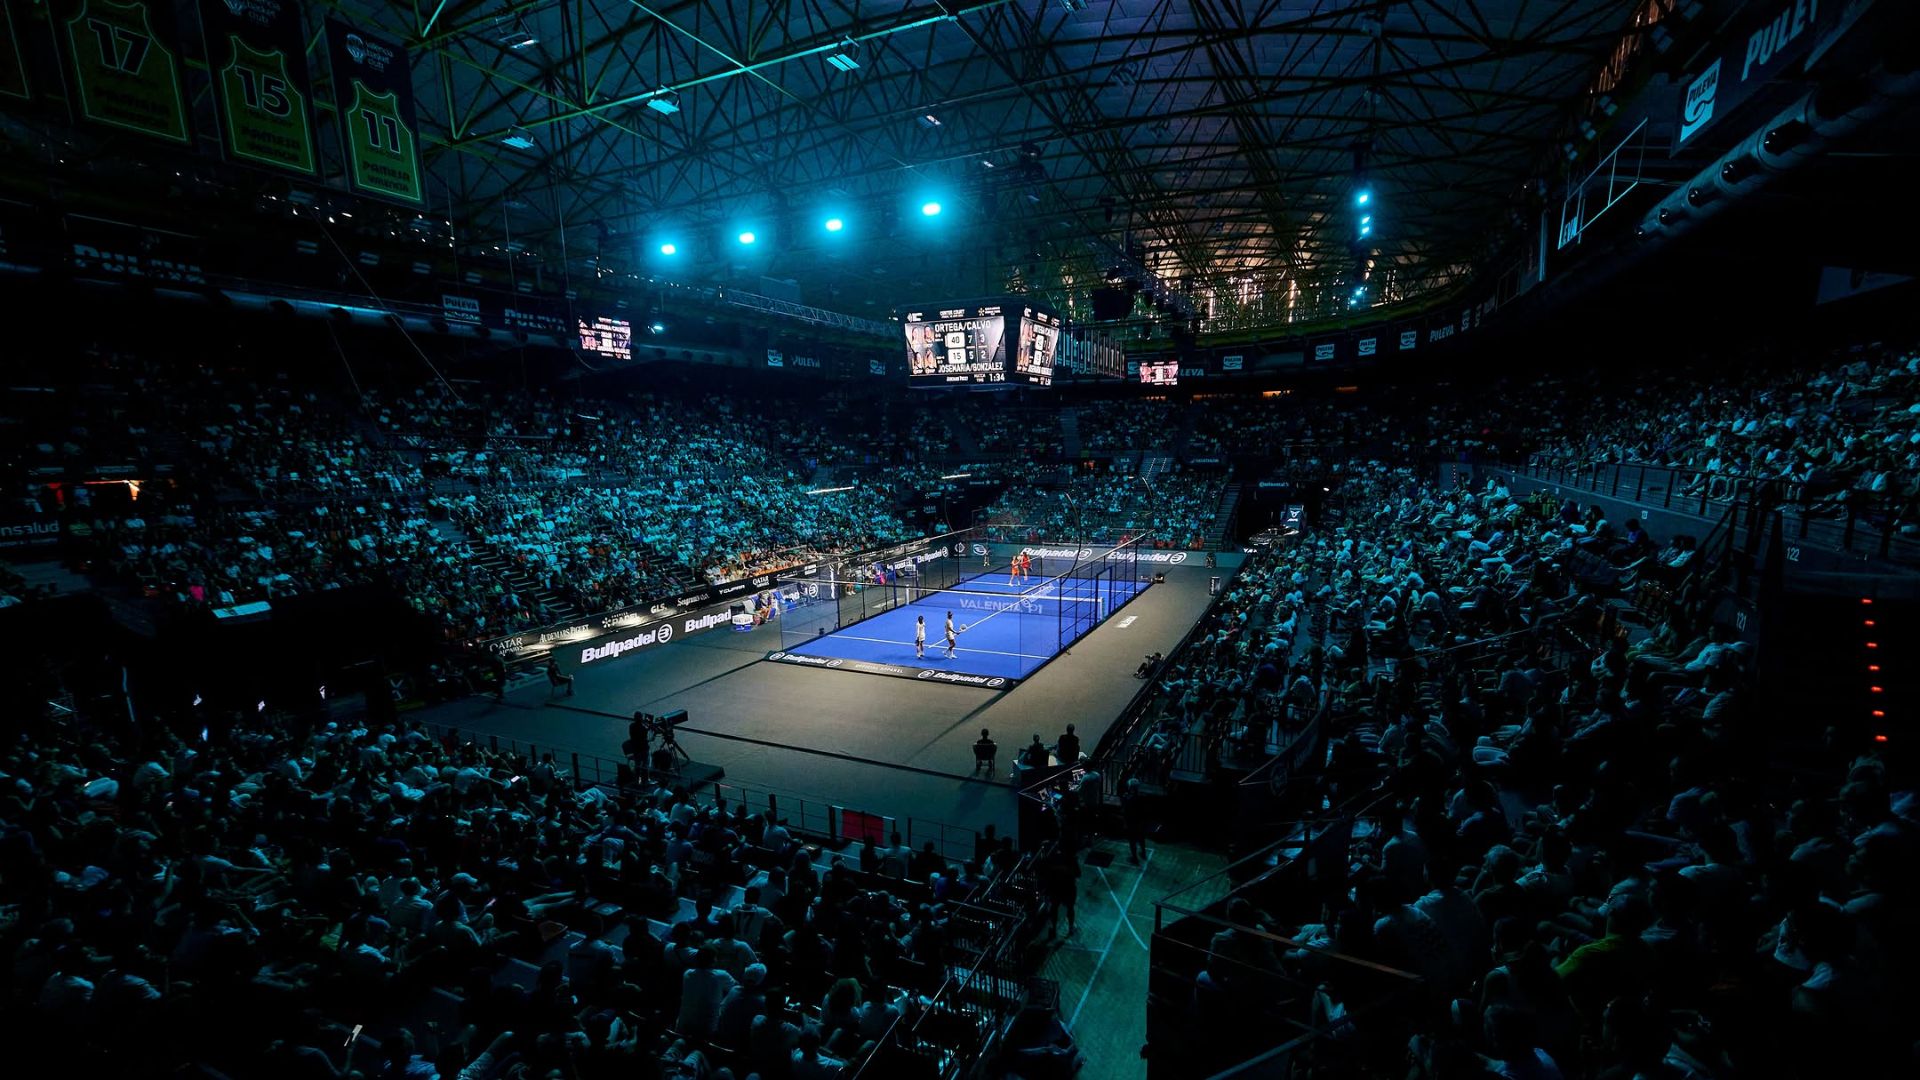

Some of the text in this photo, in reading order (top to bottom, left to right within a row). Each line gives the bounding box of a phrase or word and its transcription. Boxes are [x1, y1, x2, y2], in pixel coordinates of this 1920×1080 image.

[87, 18, 150, 76] 17
[235, 66, 291, 117] 15
[361, 108, 400, 153] 11
[951, 336, 960, 344] 40
[967, 335, 973, 344] 7
[980, 334, 985, 343] 3
[952, 352, 962, 360] 15
[969, 351, 974, 360] 5
[981, 351, 986, 359] 2
[989, 373, 1005, 382] 1:34
[1020, 547, 1075, 561] Bullpadel
[684, 608, 732, 633] Bullpad
[580, 628, 656, 663] Bullpadel
